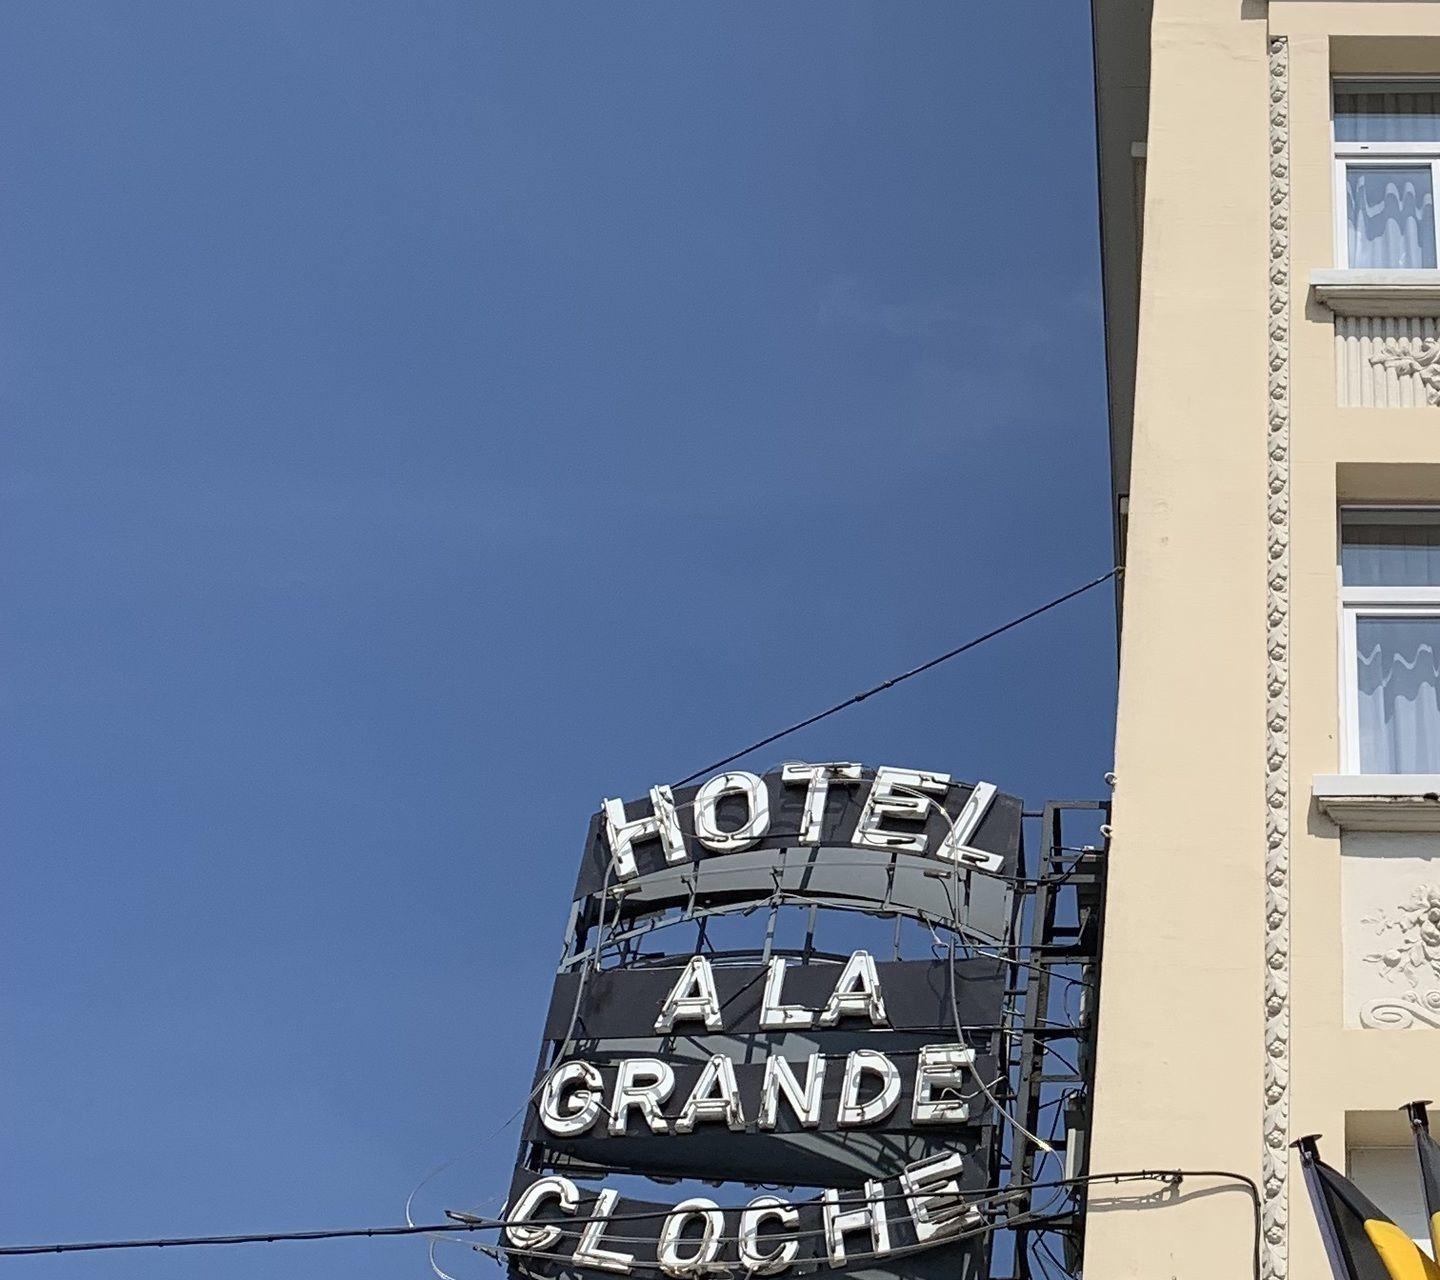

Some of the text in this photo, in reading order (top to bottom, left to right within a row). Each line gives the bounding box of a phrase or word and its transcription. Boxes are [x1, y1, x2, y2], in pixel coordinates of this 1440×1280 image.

[602, 762, 1004, 879] HOTEL
[654, 950, 889, 1033] A LA
[538, 1044, 976, 1136] GRANDE
[505, 1151, 982, 1277] CLOCHE
